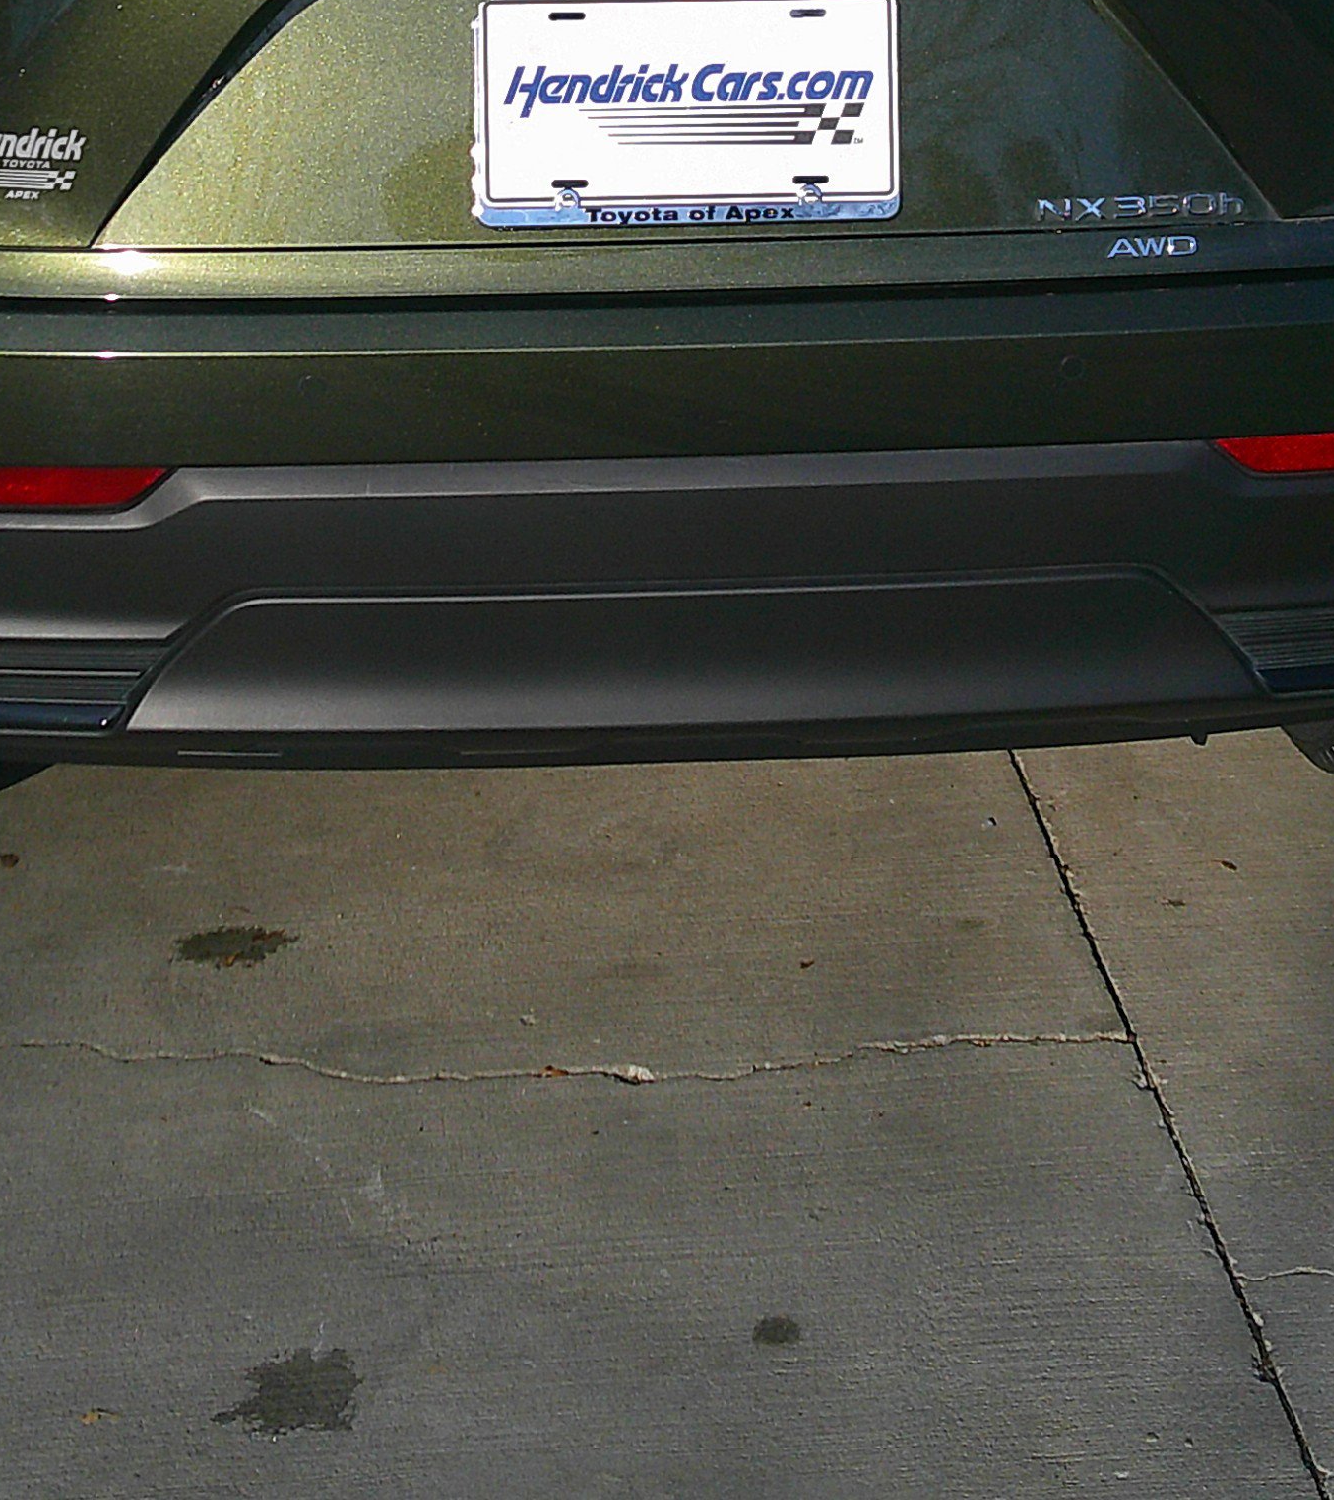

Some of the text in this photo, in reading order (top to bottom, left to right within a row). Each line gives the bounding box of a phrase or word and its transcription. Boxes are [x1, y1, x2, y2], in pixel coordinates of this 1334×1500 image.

[2, 158, 51, 169] TOYOTA
[4, 189, 41, 200] APEX
[584, 204, 795, 225] Toyota of Apex
[1106, 234, 1199, 260] AWD
